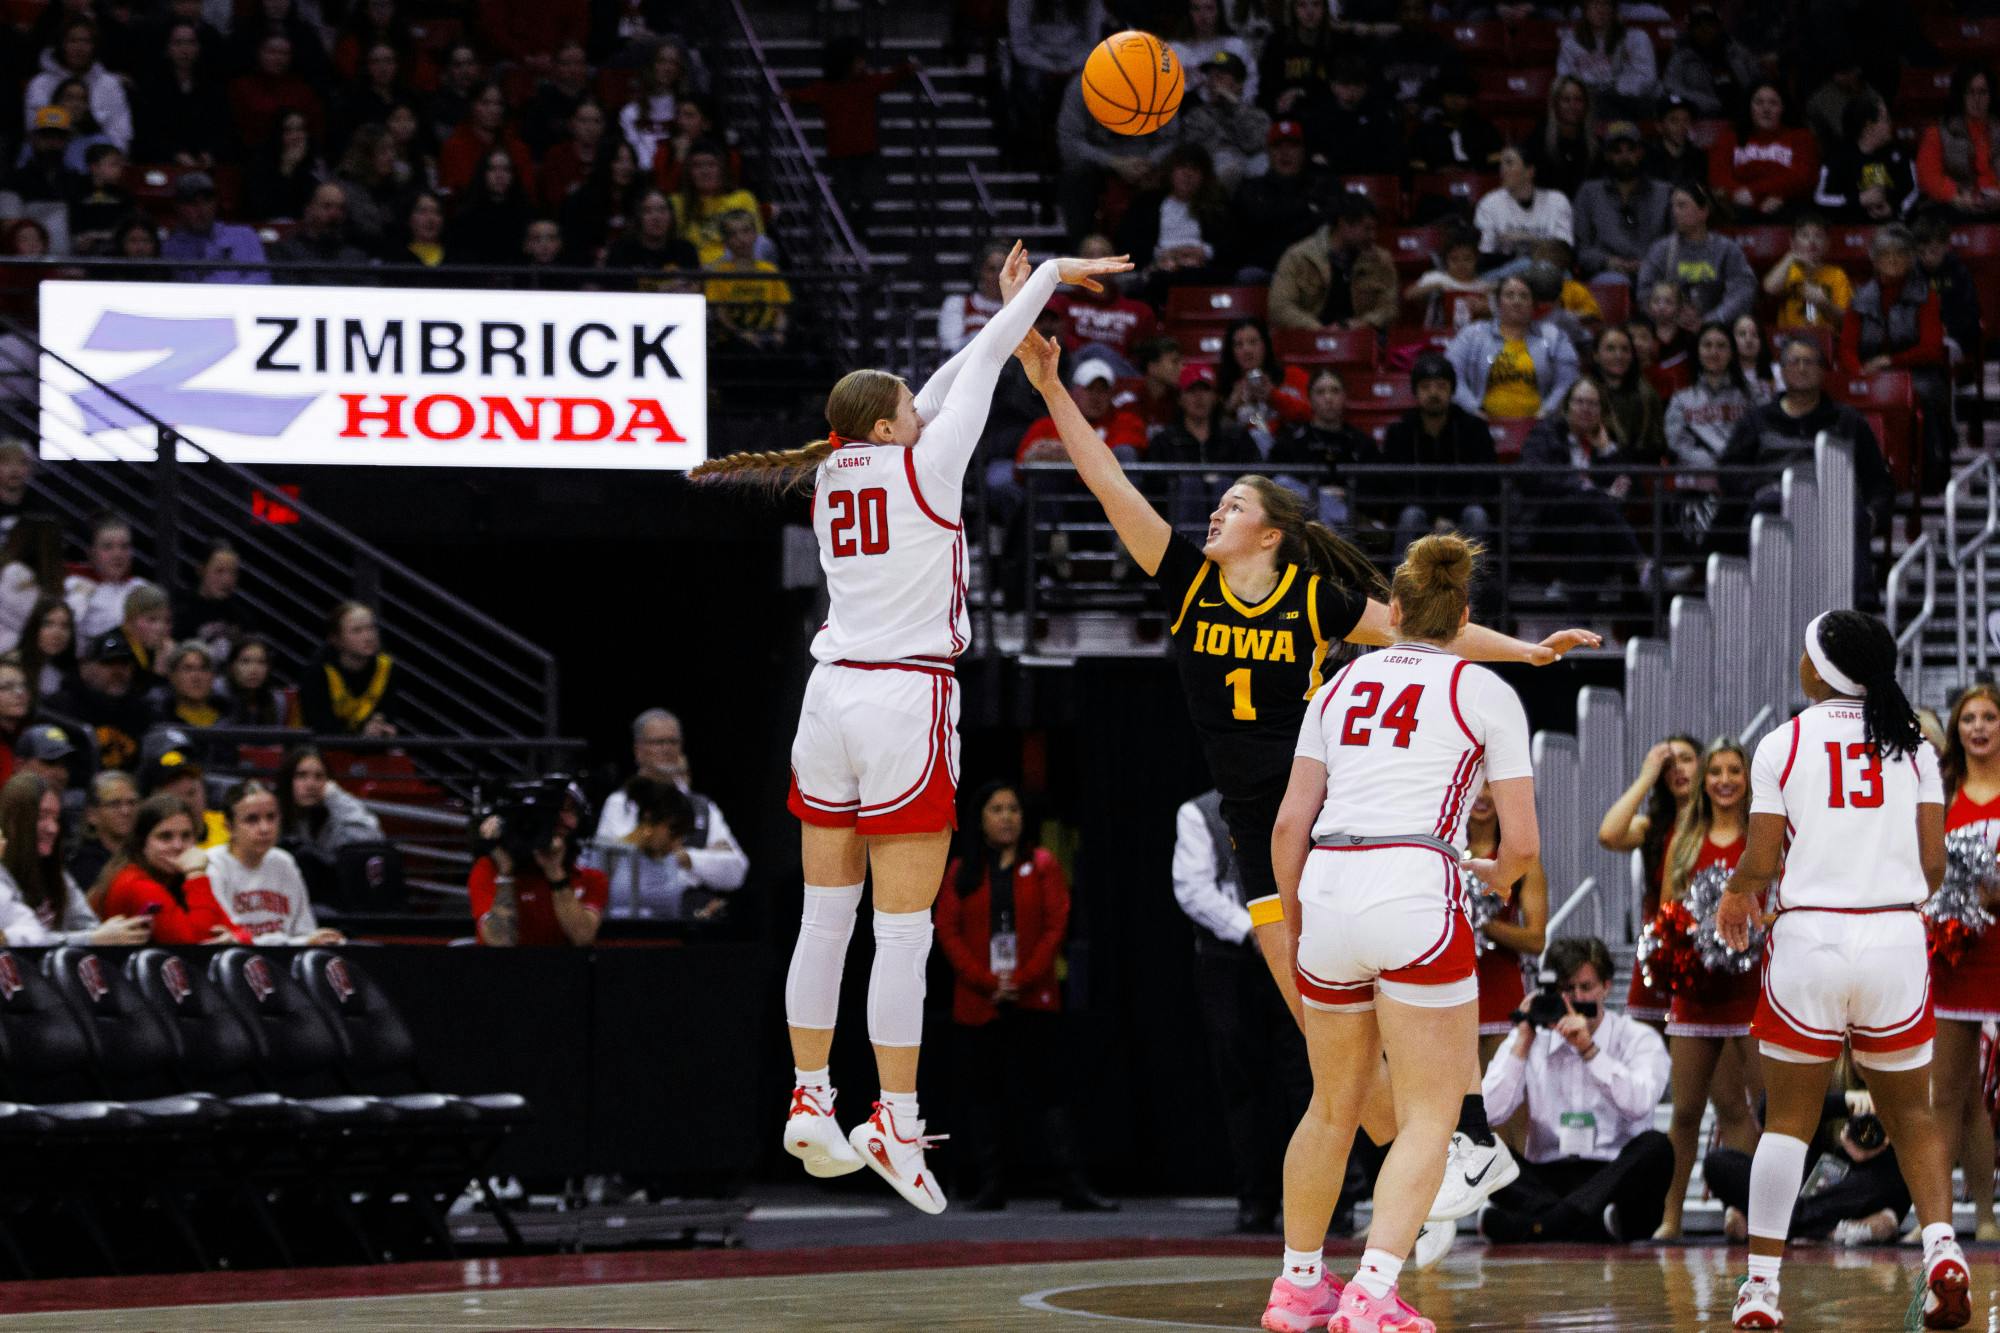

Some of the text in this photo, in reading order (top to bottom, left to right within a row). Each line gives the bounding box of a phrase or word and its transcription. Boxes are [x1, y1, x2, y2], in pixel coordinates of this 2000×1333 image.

[256, 317, 682, 378] ZIMBRICK
[339, 393, 687, 444] HONDA
[837, 456, 871, 468] LEGACY
[828, 487, 889, 558] 20
[1193, 620, 1297, 663] IOWA
[1383, 655, 1423, 665] LEGACY
[1225, 667, 1257, 721] 1
[1340, 681, 1426, 749] 24
[1828, 710, 1865, 720] LEGAC
[1824, 741, 1885, 809] 13
